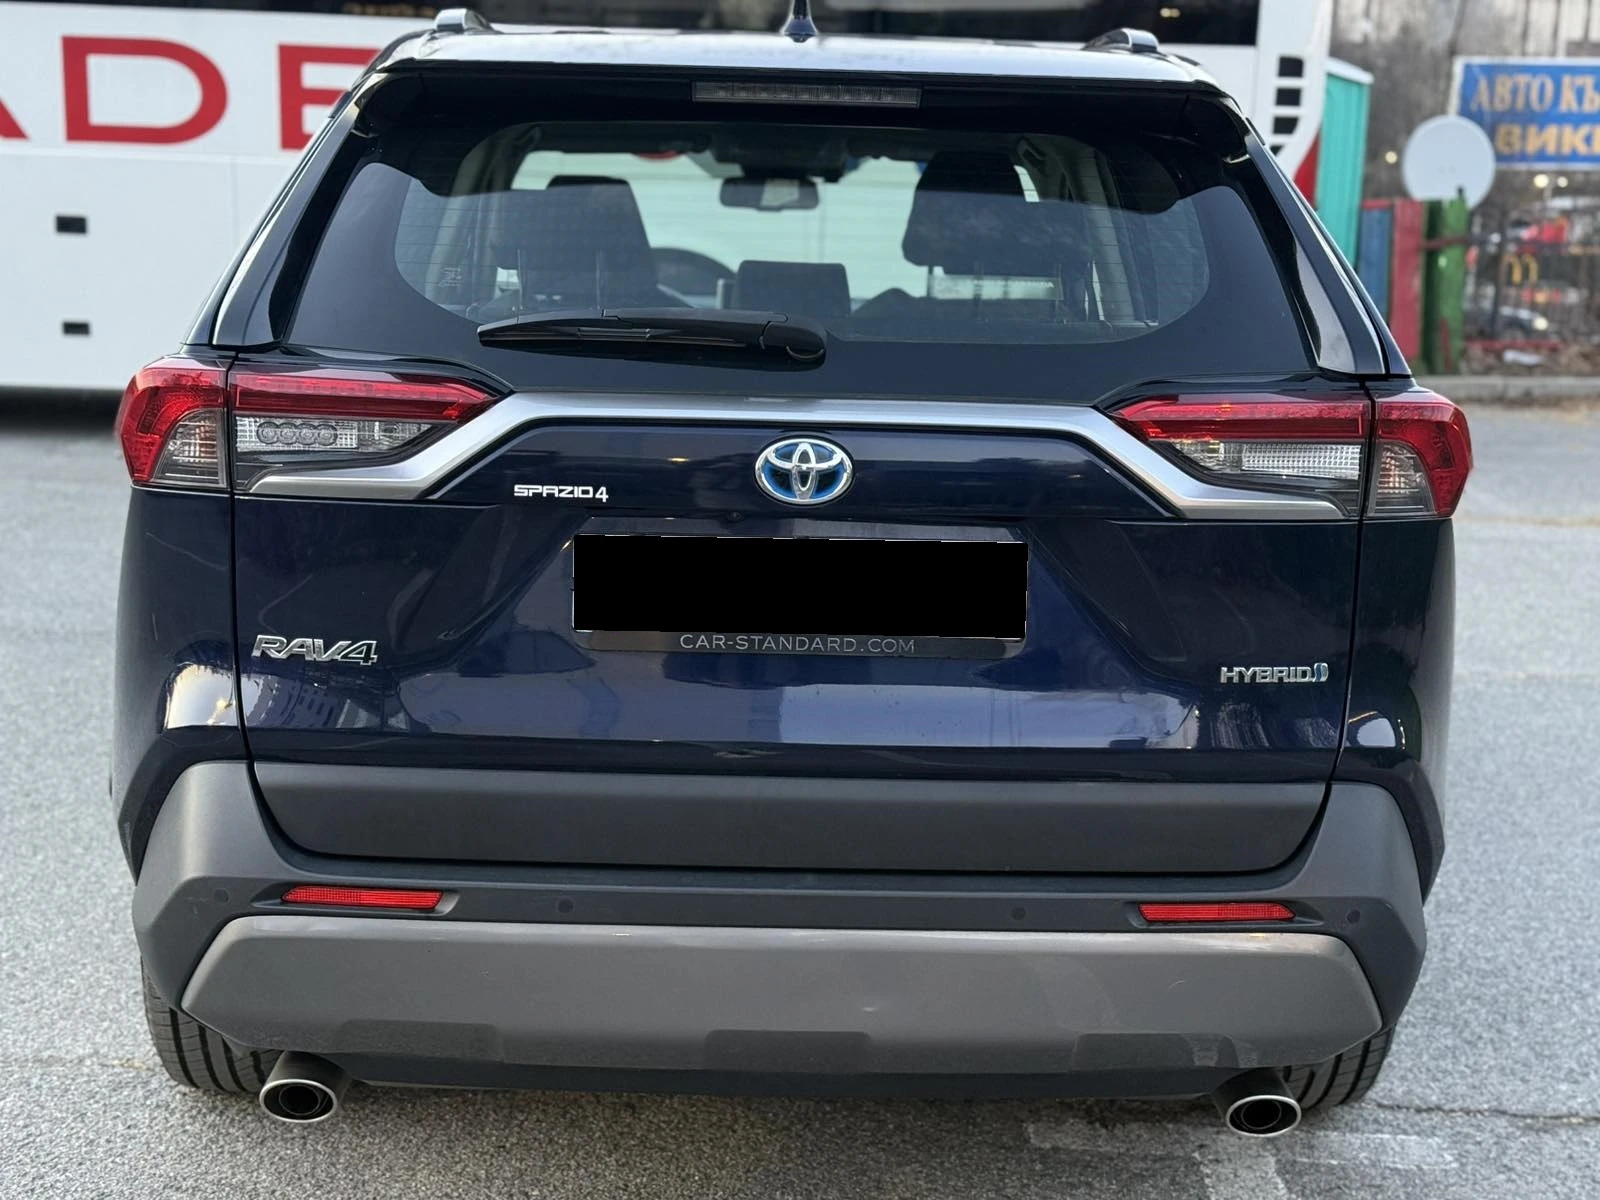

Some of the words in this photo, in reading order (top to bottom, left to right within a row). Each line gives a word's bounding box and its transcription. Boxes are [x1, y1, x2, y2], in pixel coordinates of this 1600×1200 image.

[0, 35, 380, 151] DE
[1470, 73, 1554, 112] АВТО
[251, 634, 378, 666] RAV4
[679, 634, 915, 654] CAR-STANDARD.COM
[1220, 666, 1315, 683] HYBRID
